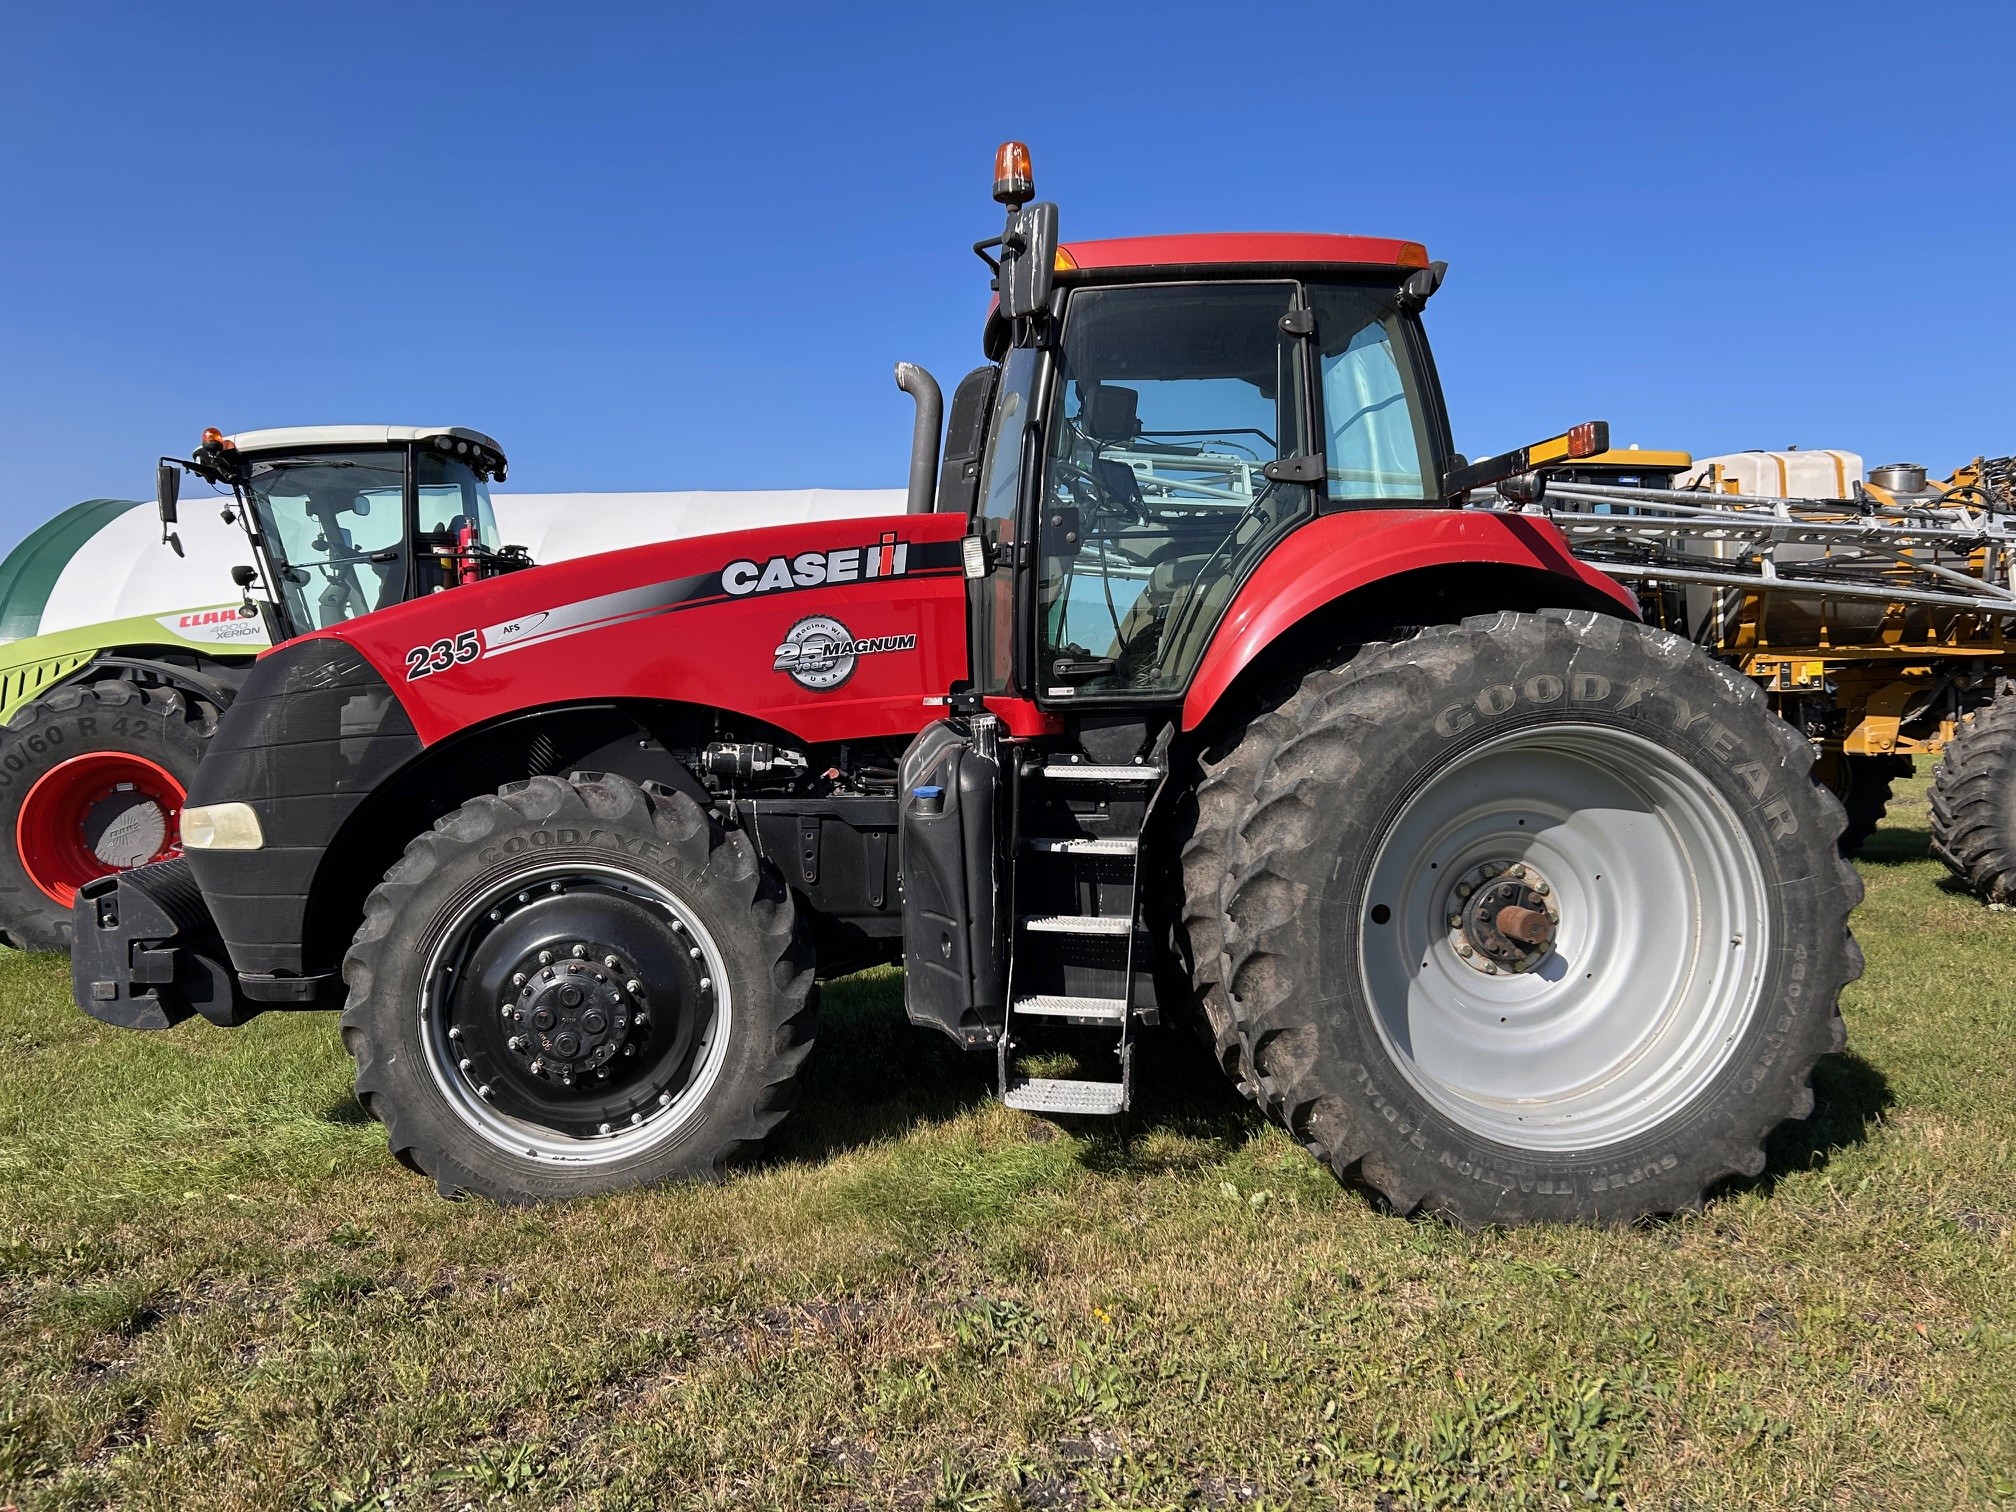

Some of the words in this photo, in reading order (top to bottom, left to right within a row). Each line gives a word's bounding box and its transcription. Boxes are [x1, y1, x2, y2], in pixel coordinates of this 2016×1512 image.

[722, 549, 860, 595] CASE
[179, 609, 247, 628] CLAA
[210, 622, 248, 633] 4000
[503, 623, 520, 634] AFS
[216, 627, 260, 640] XERION
[821, 633, 916, 658] MAGNUM
[405, 630, 480, 681] 235
[774, 640, 826, 673] 25
[794, 658, 835, 673] years
[77, 717, 99, 738] R
[111, 717, 149, 741] 42
[1357, 1063, 1427, 1149] RADIAL
[437, 1147, 498, 1190] RADIAL
[1438, 1150, 1574, 1195] TRACTION
[1592, 1153, 1679, 1192] SUPER
